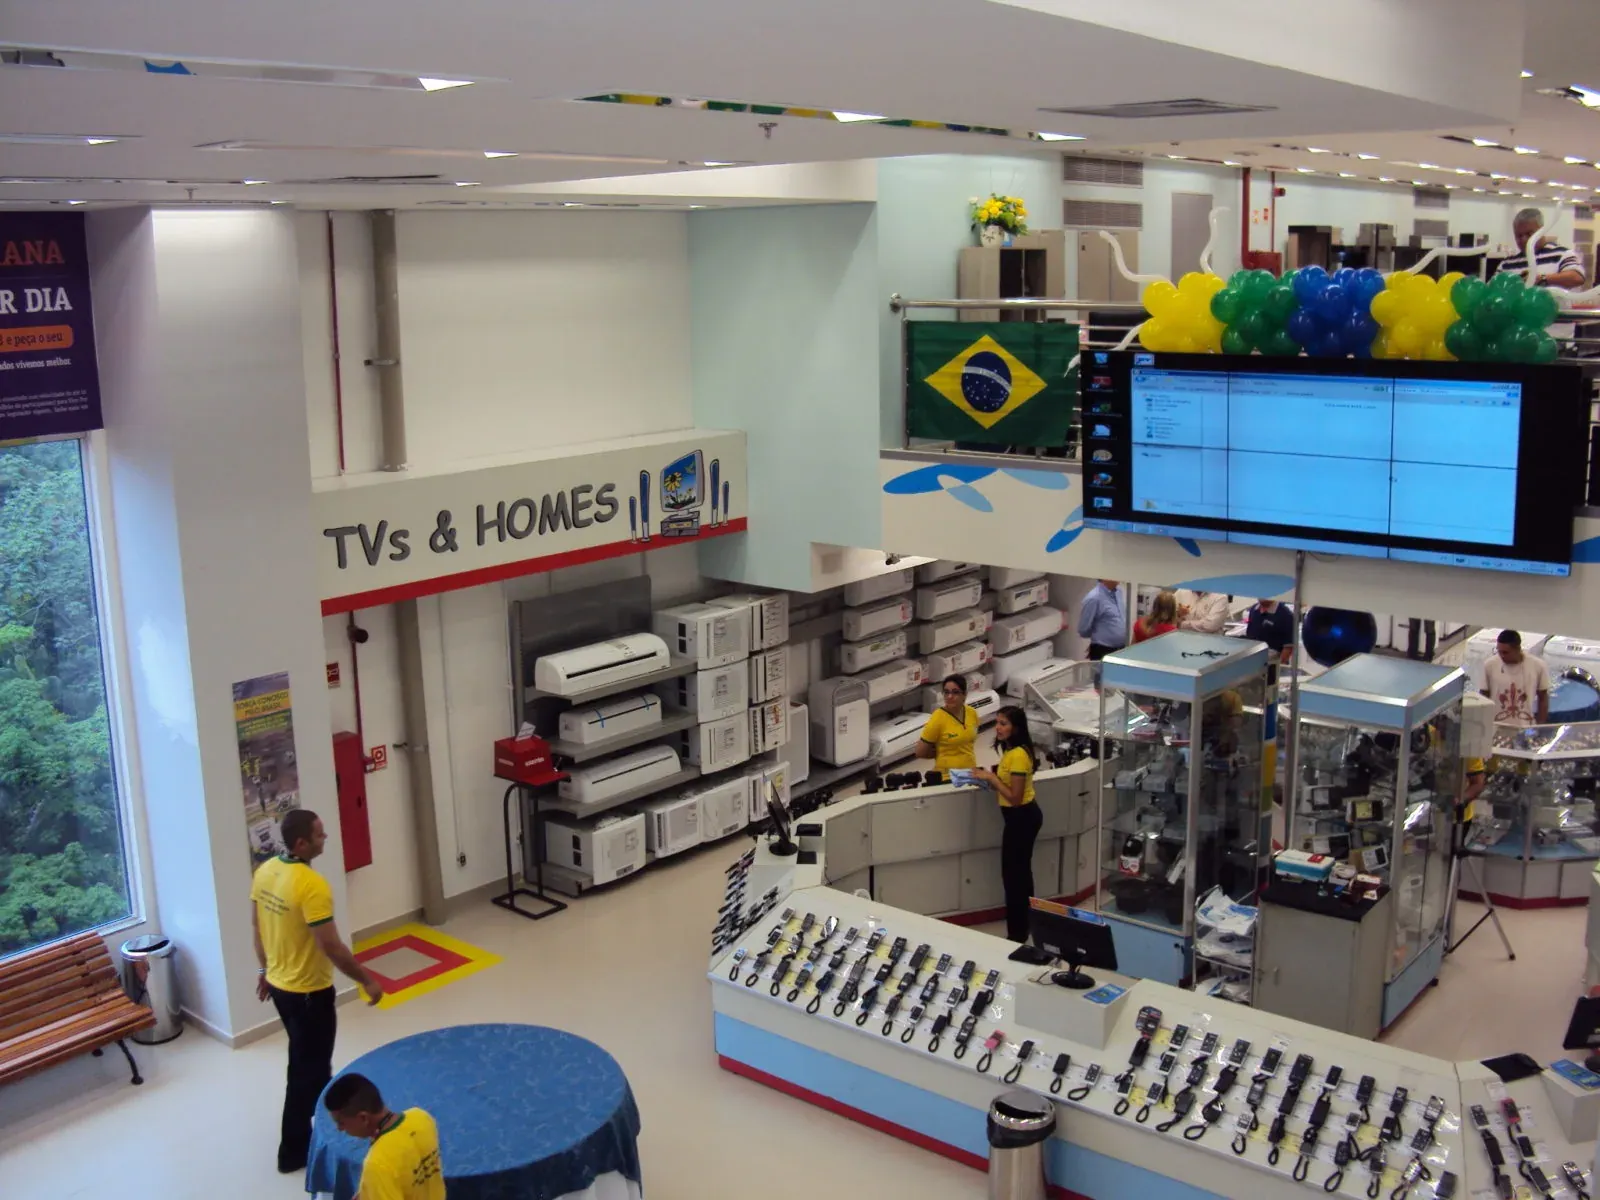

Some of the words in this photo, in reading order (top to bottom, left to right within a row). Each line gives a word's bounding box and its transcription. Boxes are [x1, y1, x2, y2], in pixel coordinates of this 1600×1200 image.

[0, 240, 65, 266] ANA
[24, 286, 73, 314] DIA
[14, 334, 36, 348] peça
[47, 332, 63, 342] seu
[16, 358, 45, 369] vivemos
[323, 519, 411, 569] TVs
[428, 509, 459, 554] &
[476, 482, 620, 547] HOMES
